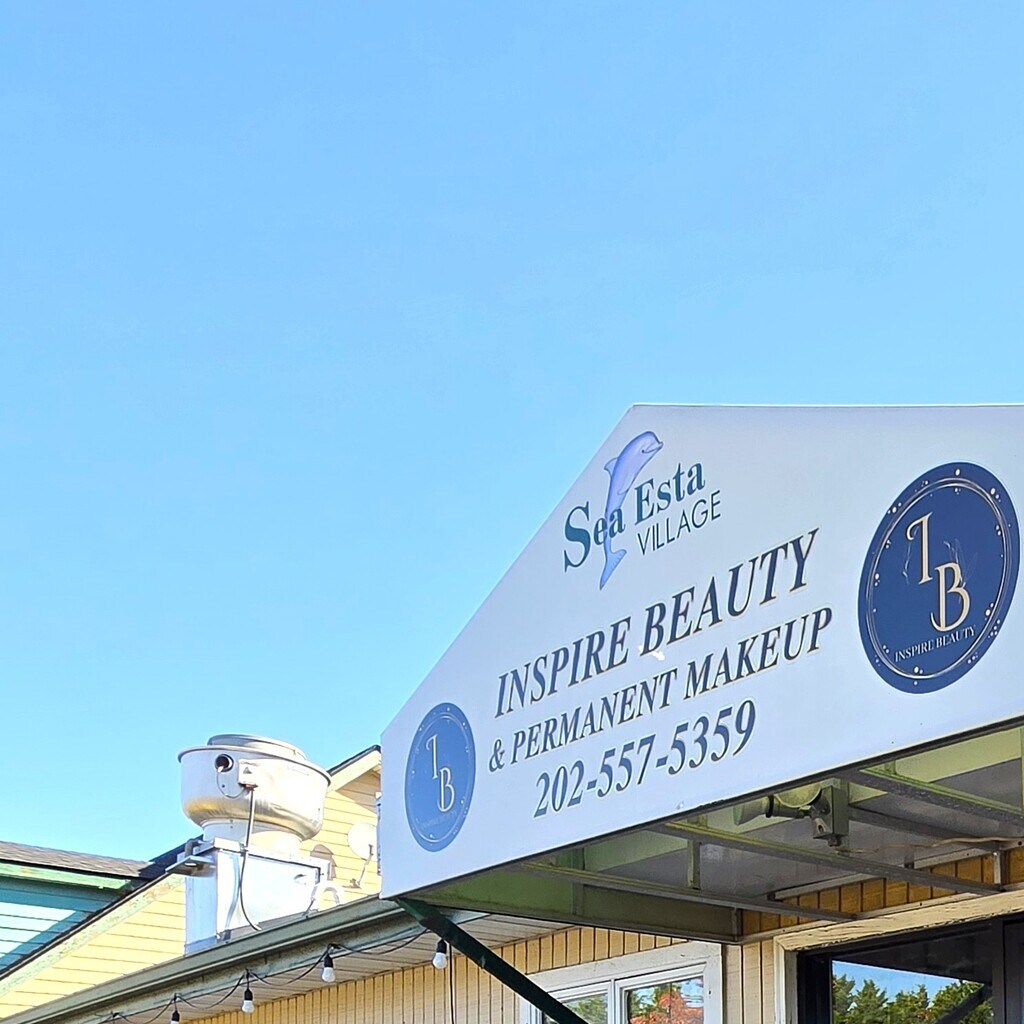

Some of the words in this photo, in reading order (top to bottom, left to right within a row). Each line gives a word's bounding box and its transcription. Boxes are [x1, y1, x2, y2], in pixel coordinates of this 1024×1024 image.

[563, 500, 626, 573] Sea
[634, 462, 706, 526] Esta
[637, 489, 721, 556] VILLAGE
[494, 616, 632, 719] INSPIRE
[640, 527, 819, 658] BEAUTY
[894, 638, 935, 662] INSPIRE
[936, 625, 976, 648] BEAUTY
[488, 738, 506, 773] &
[510, 667, 678, 764] PERMANENT
[683, 606, 833, 701] MAKEUP
[533, 698, 757, 819] 202-557-5359
